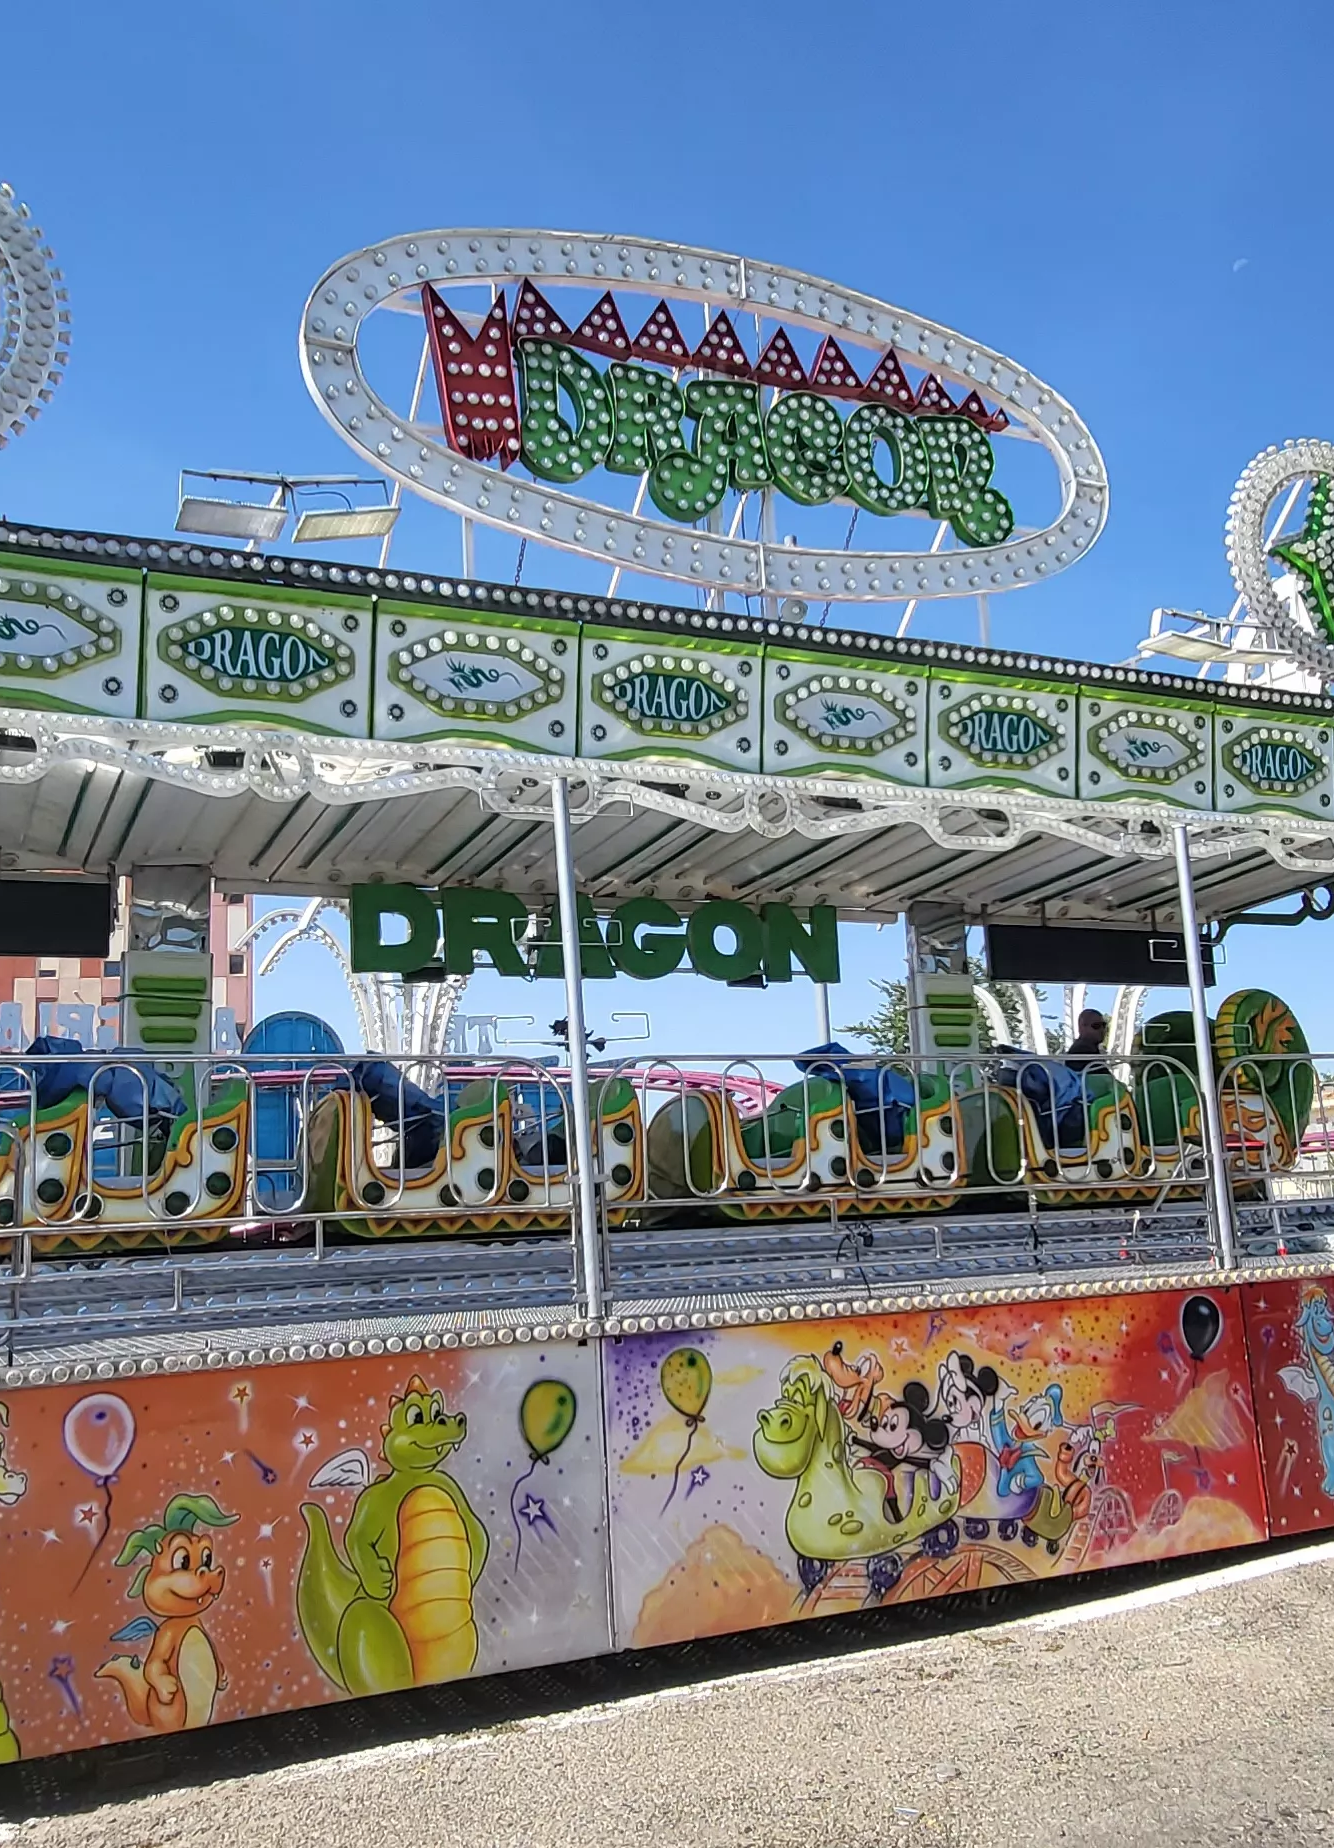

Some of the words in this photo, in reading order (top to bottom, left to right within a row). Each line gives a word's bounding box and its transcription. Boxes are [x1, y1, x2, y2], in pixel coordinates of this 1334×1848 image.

[517, 335, 1015, 548] DRAGON
[186, 629, 329, 680] DRAGON
[613, 674, 727, 720] DRAGON
[957, 712, 1050, 752] DRAGON
[349, 883, 841, 984] DRAGON
